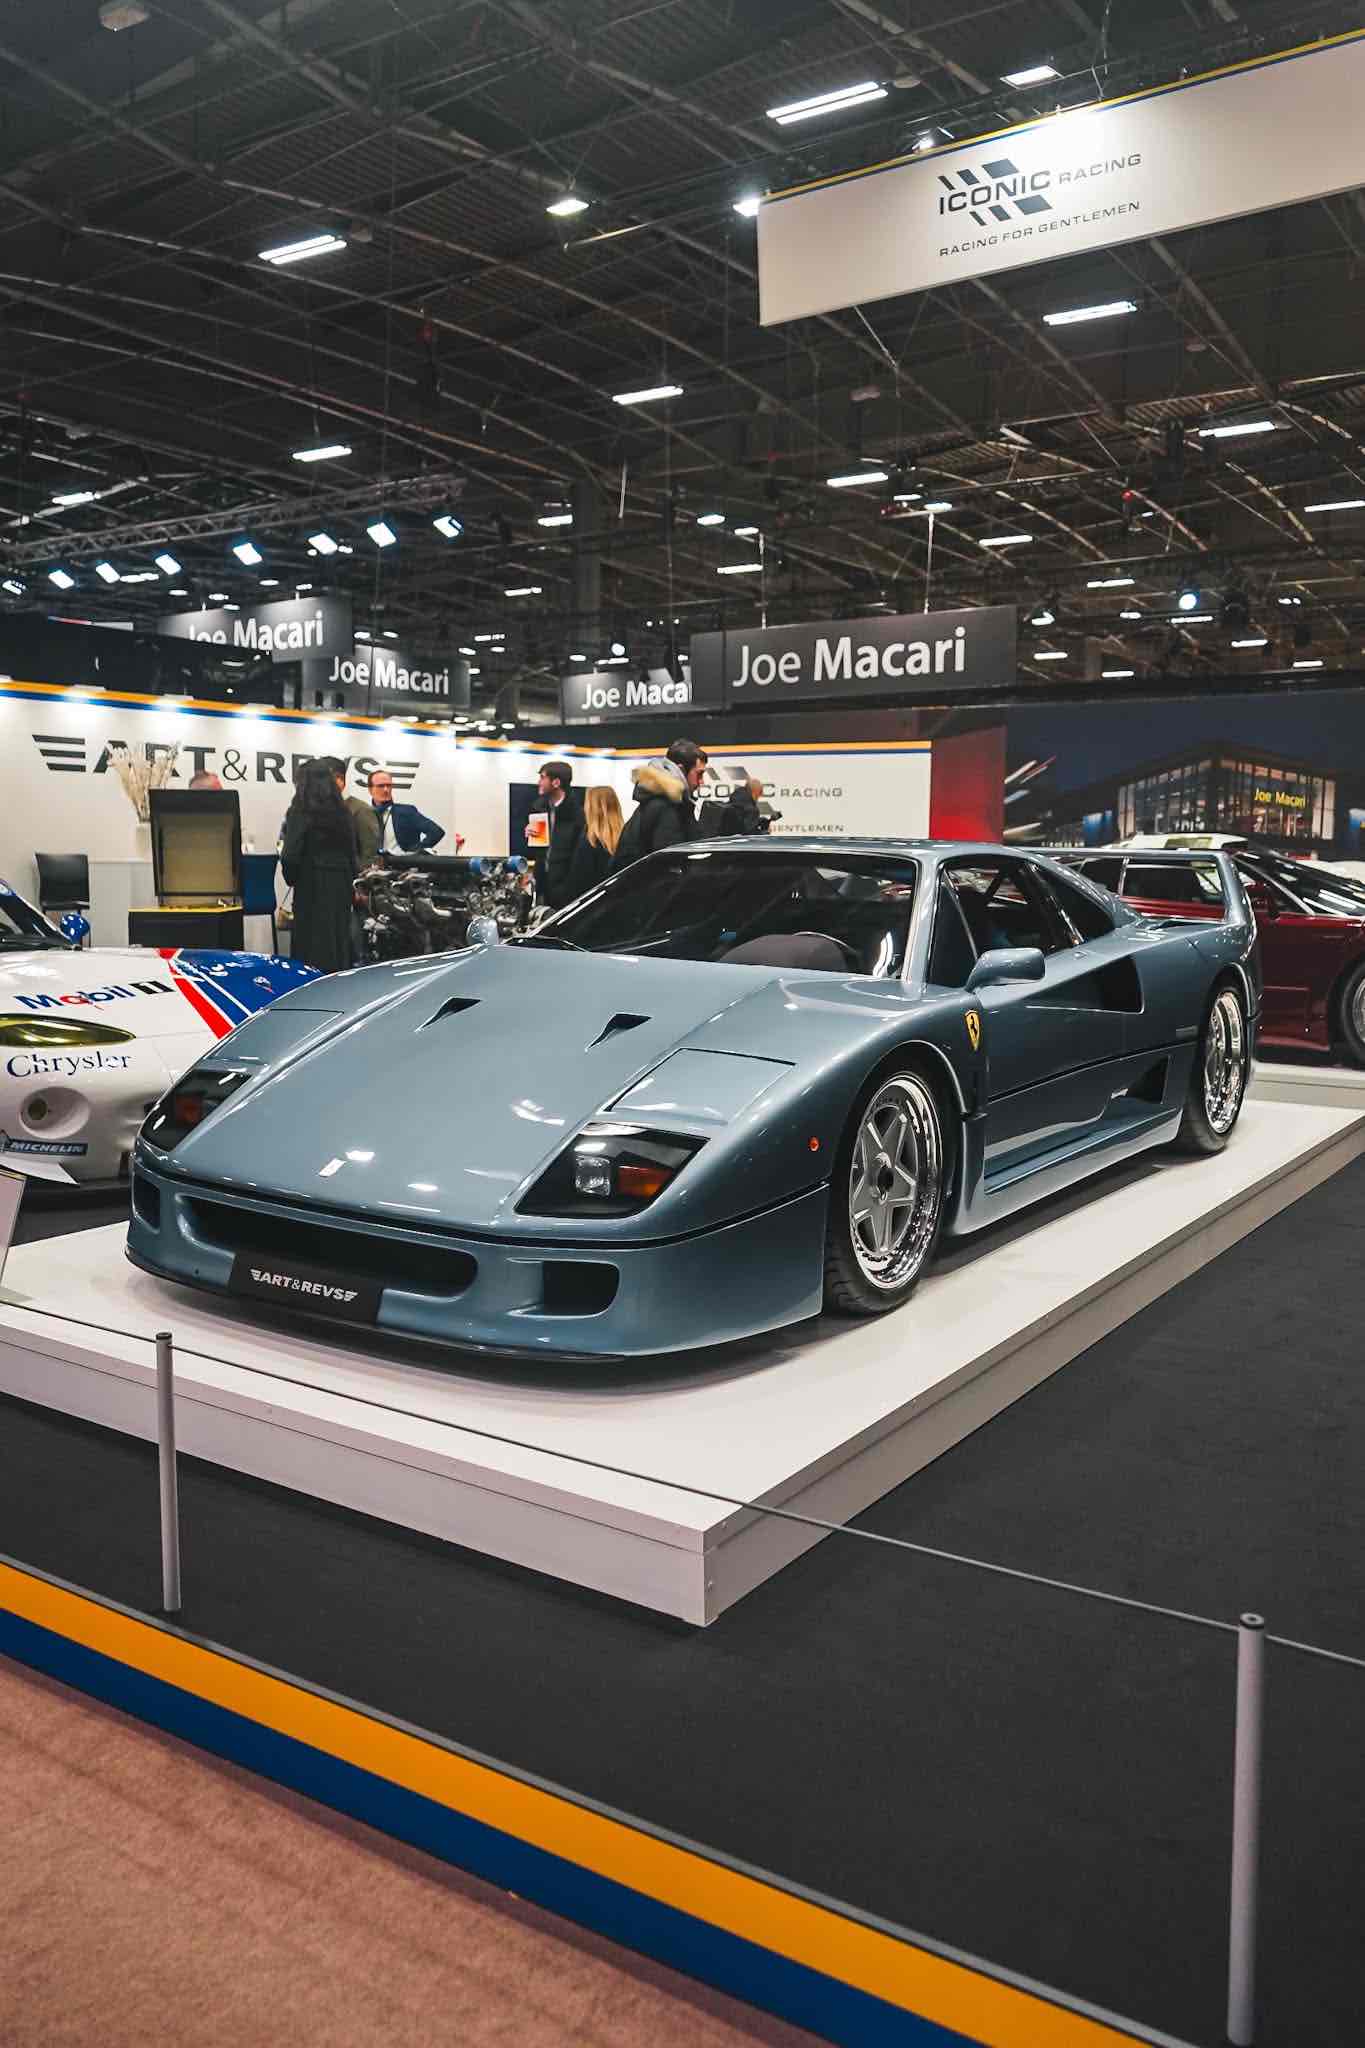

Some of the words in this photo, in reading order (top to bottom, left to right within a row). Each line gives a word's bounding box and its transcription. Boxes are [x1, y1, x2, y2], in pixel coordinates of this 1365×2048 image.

[939, 170, 1051, 215] ICONIC
[1058, 154, 1142, 185] RACING
[939, 236, 998, 257] RACING
[1002, 227, 1034, 241] FOR
[1038, 201, 1141, 233] GENTLEMEN
[233, 610, 323, 650] Macari
[732, 645, 801, 687] Joe
[813, 626, 966, 681] Macari
[328, 655, 370, 686] Joe
[374, 658, 449, 695] Macari
[581, 683, 621, 710] Joe
[625, 680, 692, 706] Maca
[780, 787, 843, 798] RACING
[14, 985, 136, 1010] Mobil
[6, 1050, 133, 1078] Chrysler
[11, 1141, 84, 1153] MICHELIN
